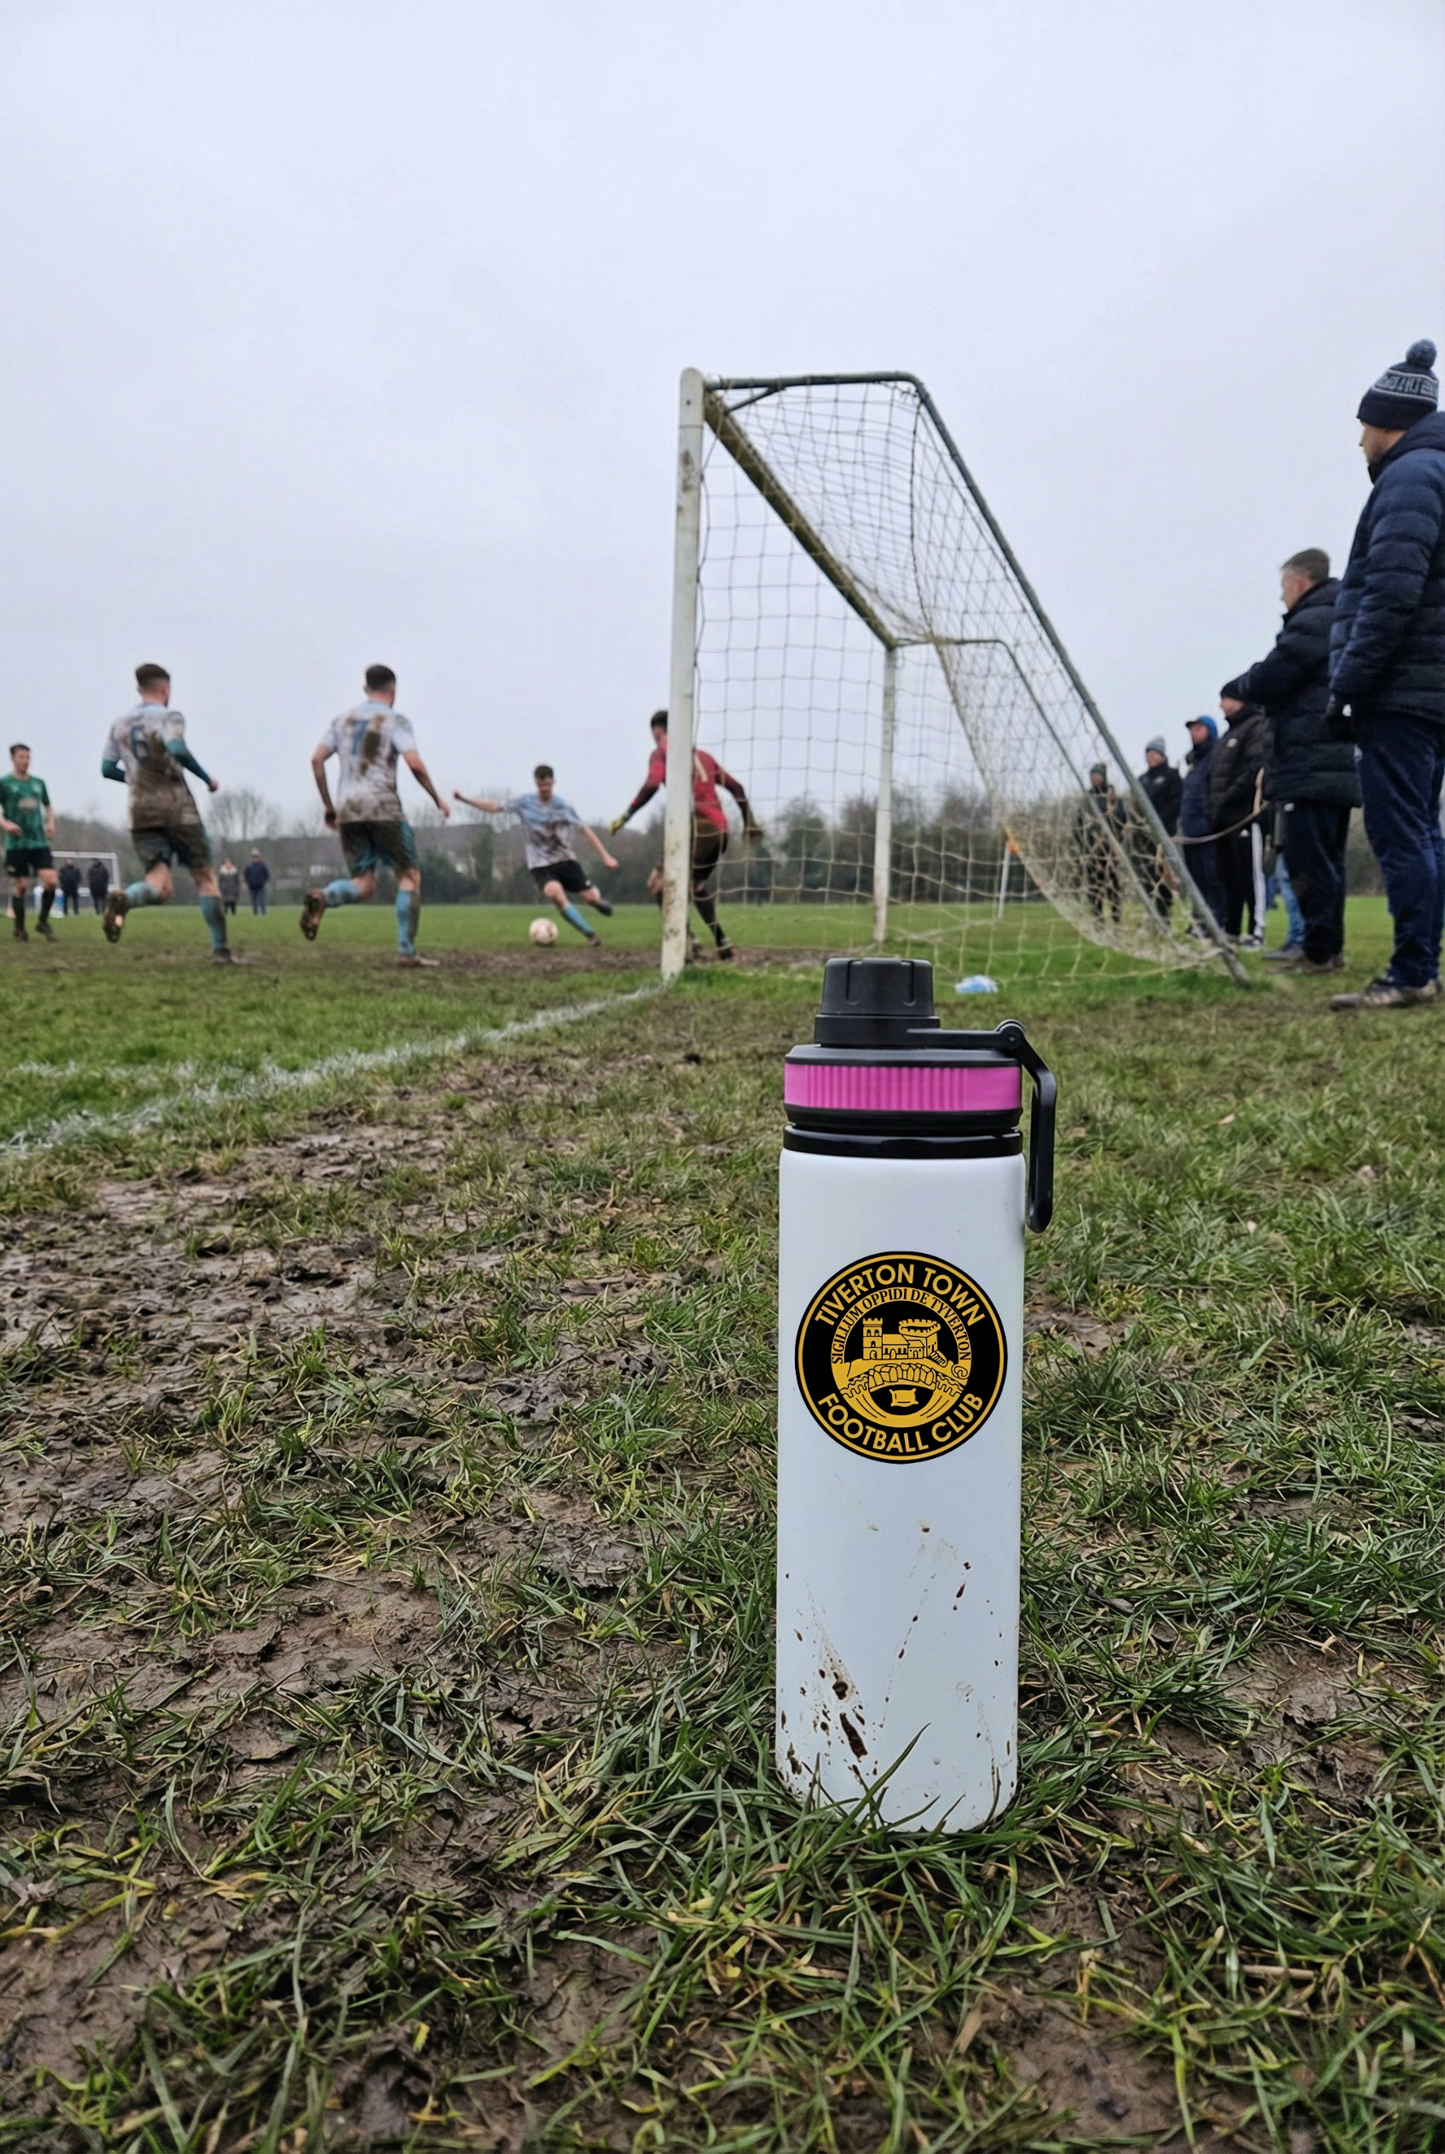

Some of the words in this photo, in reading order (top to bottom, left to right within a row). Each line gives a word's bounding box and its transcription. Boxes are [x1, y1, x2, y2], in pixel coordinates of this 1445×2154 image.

[130, 724, 150, 763] 6
[352, 719, 369, 756] 7
[815, 1264, 914, 1327] TIVERTON
[923, 1267, 985, 1327] TOWN
[831, 1306, 864, 1364] SIGILLUM
[862, 1288, 907, 1310] OPPIDI
[910, 1288, 929, 1305] DE
[932, 1296, 972, 1361] TYVERTON
[818, 1393, 929, 1453] FOOTBALL
[931, 1393, 984, 1442] CLUB
